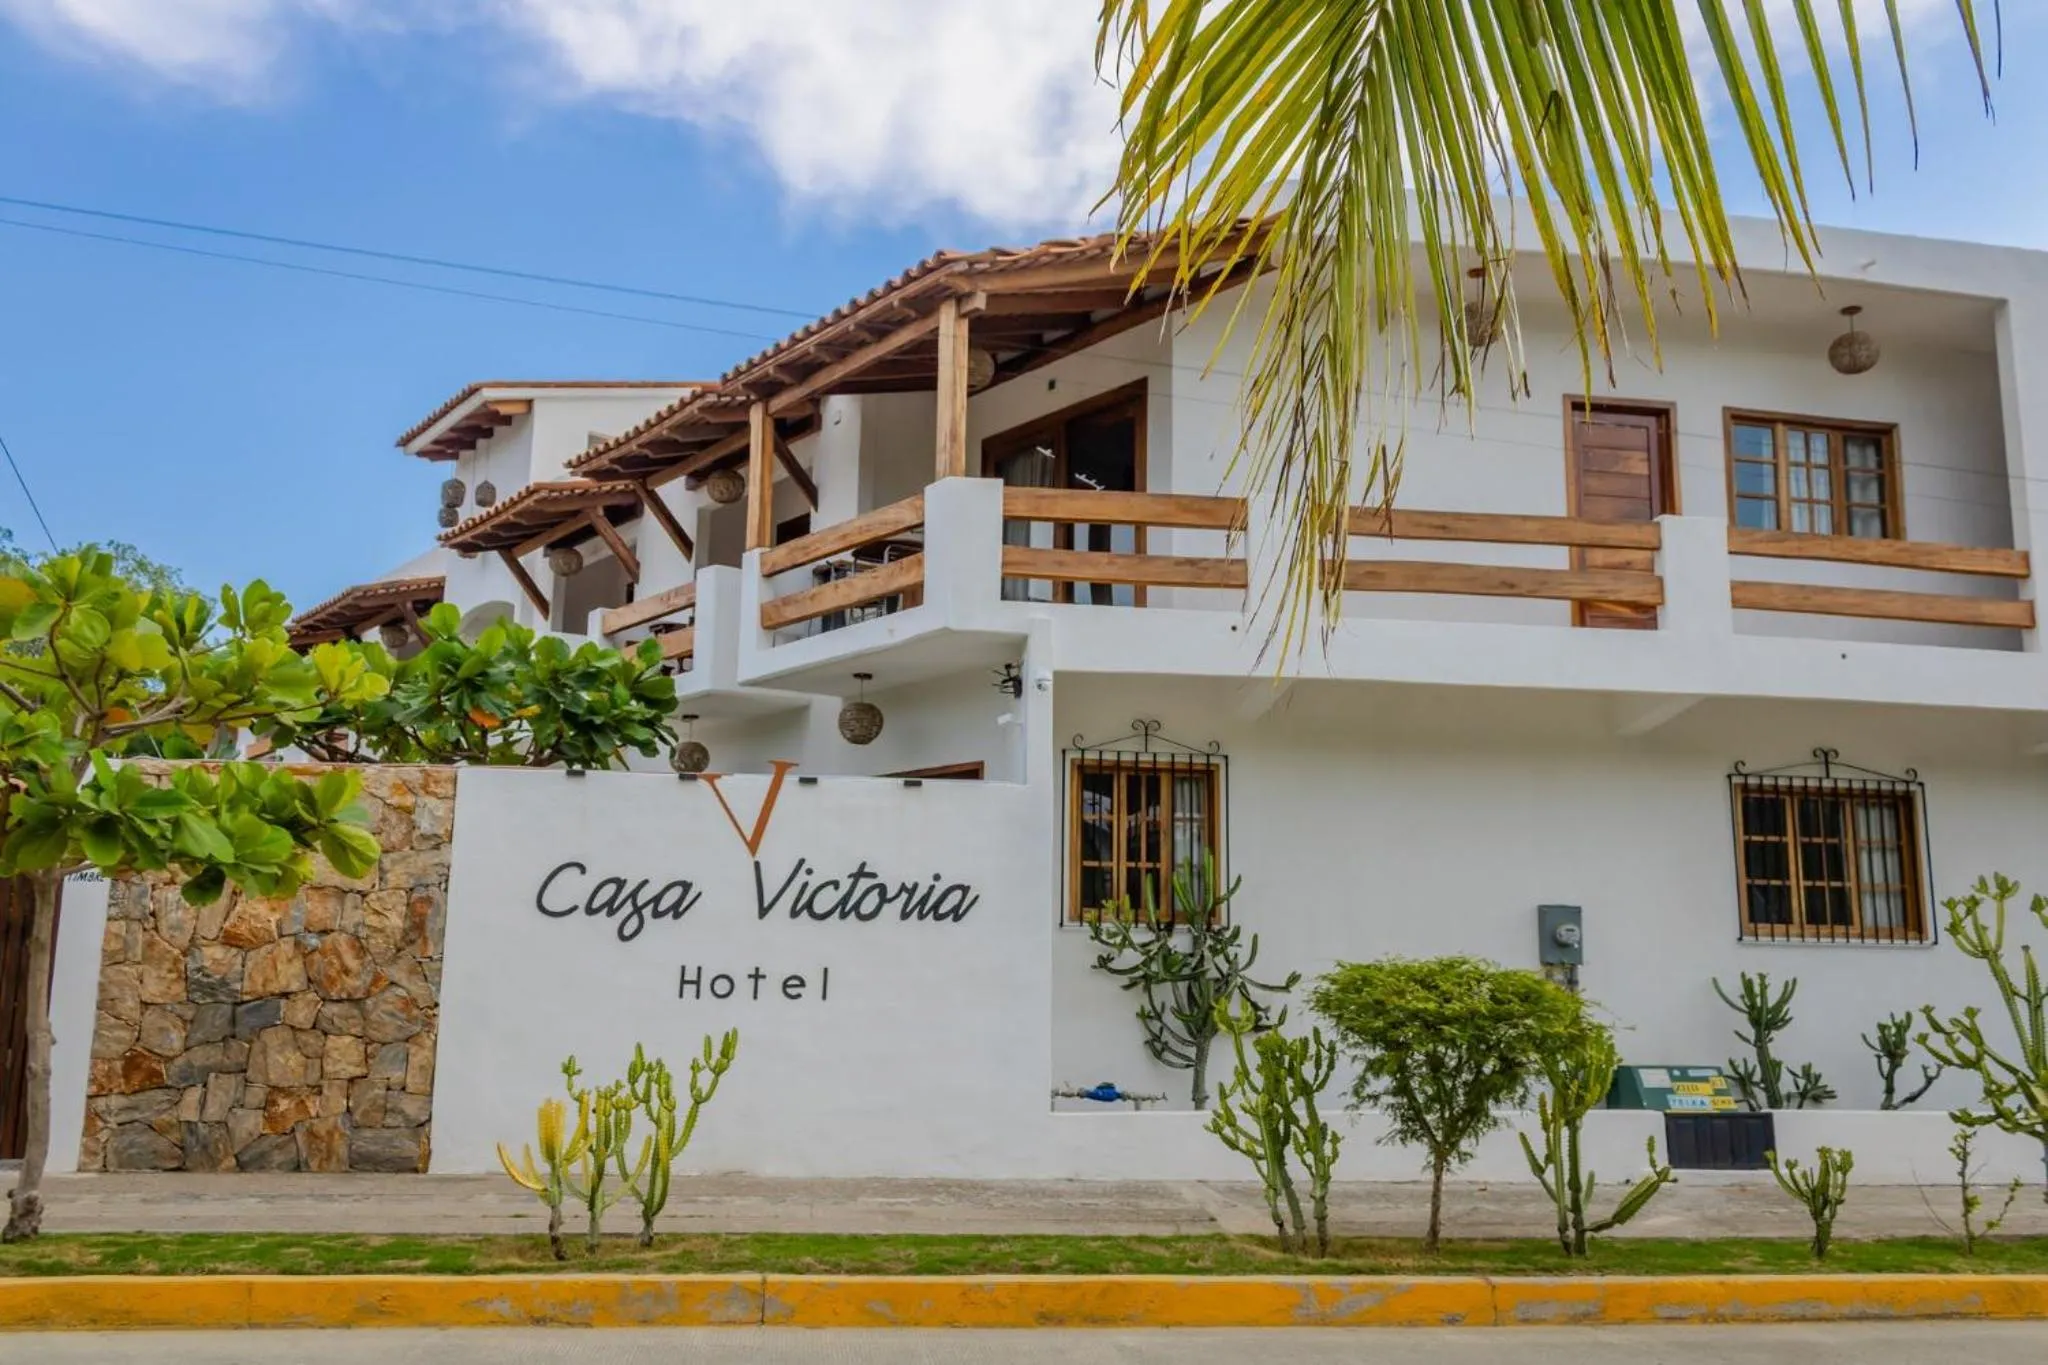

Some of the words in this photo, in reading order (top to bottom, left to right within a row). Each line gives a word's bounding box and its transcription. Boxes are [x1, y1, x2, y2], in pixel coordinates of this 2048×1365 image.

[702, 760, 799, 857] V
[536, 861, 702, 942] Casa
[753, 858, 980, 922] Victoria
[679, 965, 828, 1000] Hotel
